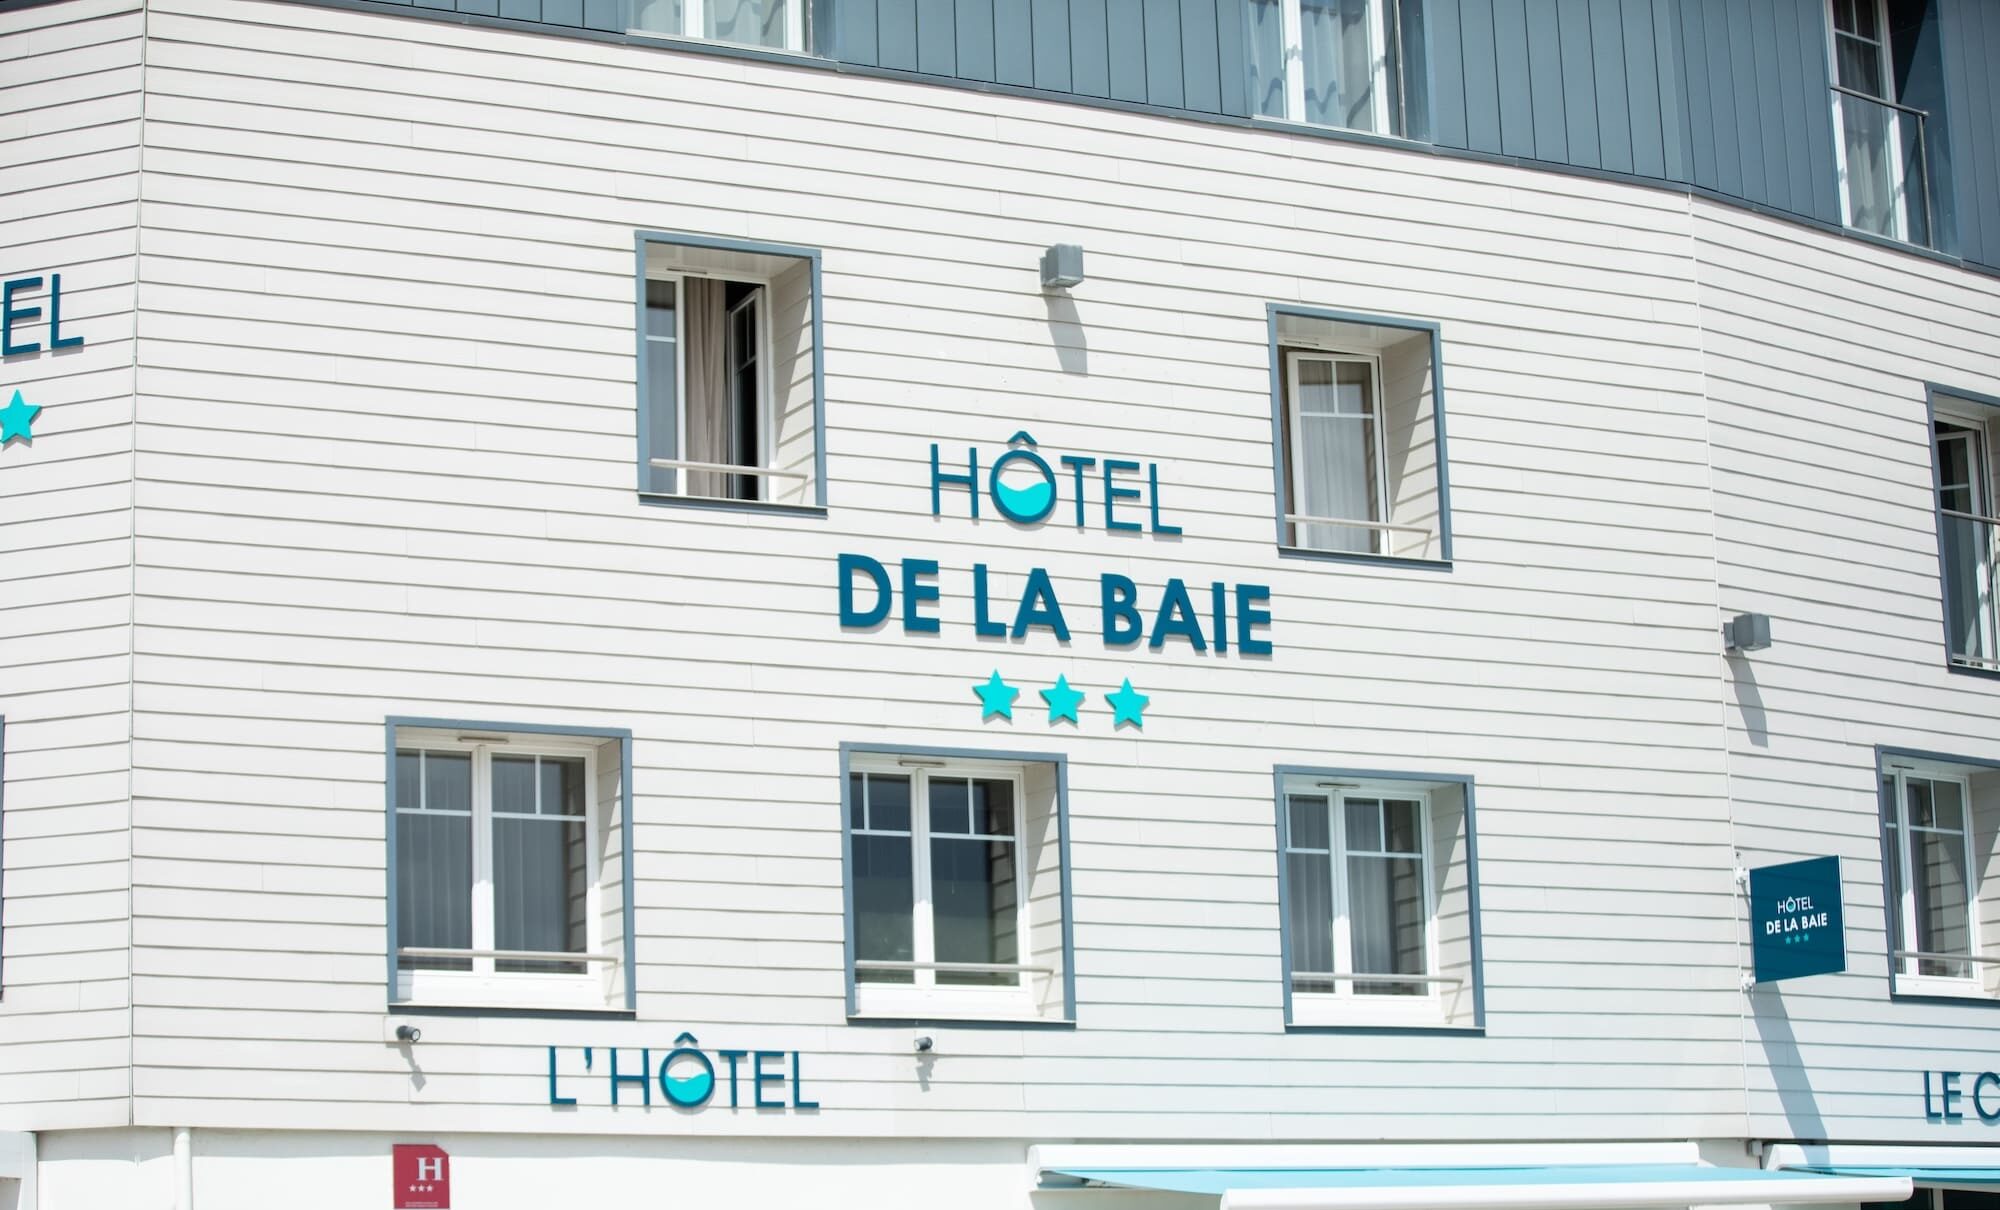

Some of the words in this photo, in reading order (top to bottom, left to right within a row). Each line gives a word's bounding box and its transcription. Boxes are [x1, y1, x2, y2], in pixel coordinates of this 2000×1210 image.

[930, 430, 1182, 535] HÔTEL
[838, 553, 940, 633] DE
[973, 563, 1071, 642] LA
[1101, 573, 1273, 655] BAIE
[1766, 920, 1781, 935] DE
[1784, 918, 1798, 932] LA
[1801, 913, 1828, 929] BAIE
[1777, 896, 1814, 914] HÔTEL
[549, 1032, 820, 1109] L'HÔTEL
[1923, 1070, 1963, 1118] LE
[416, 1157, 444, 1181] H
